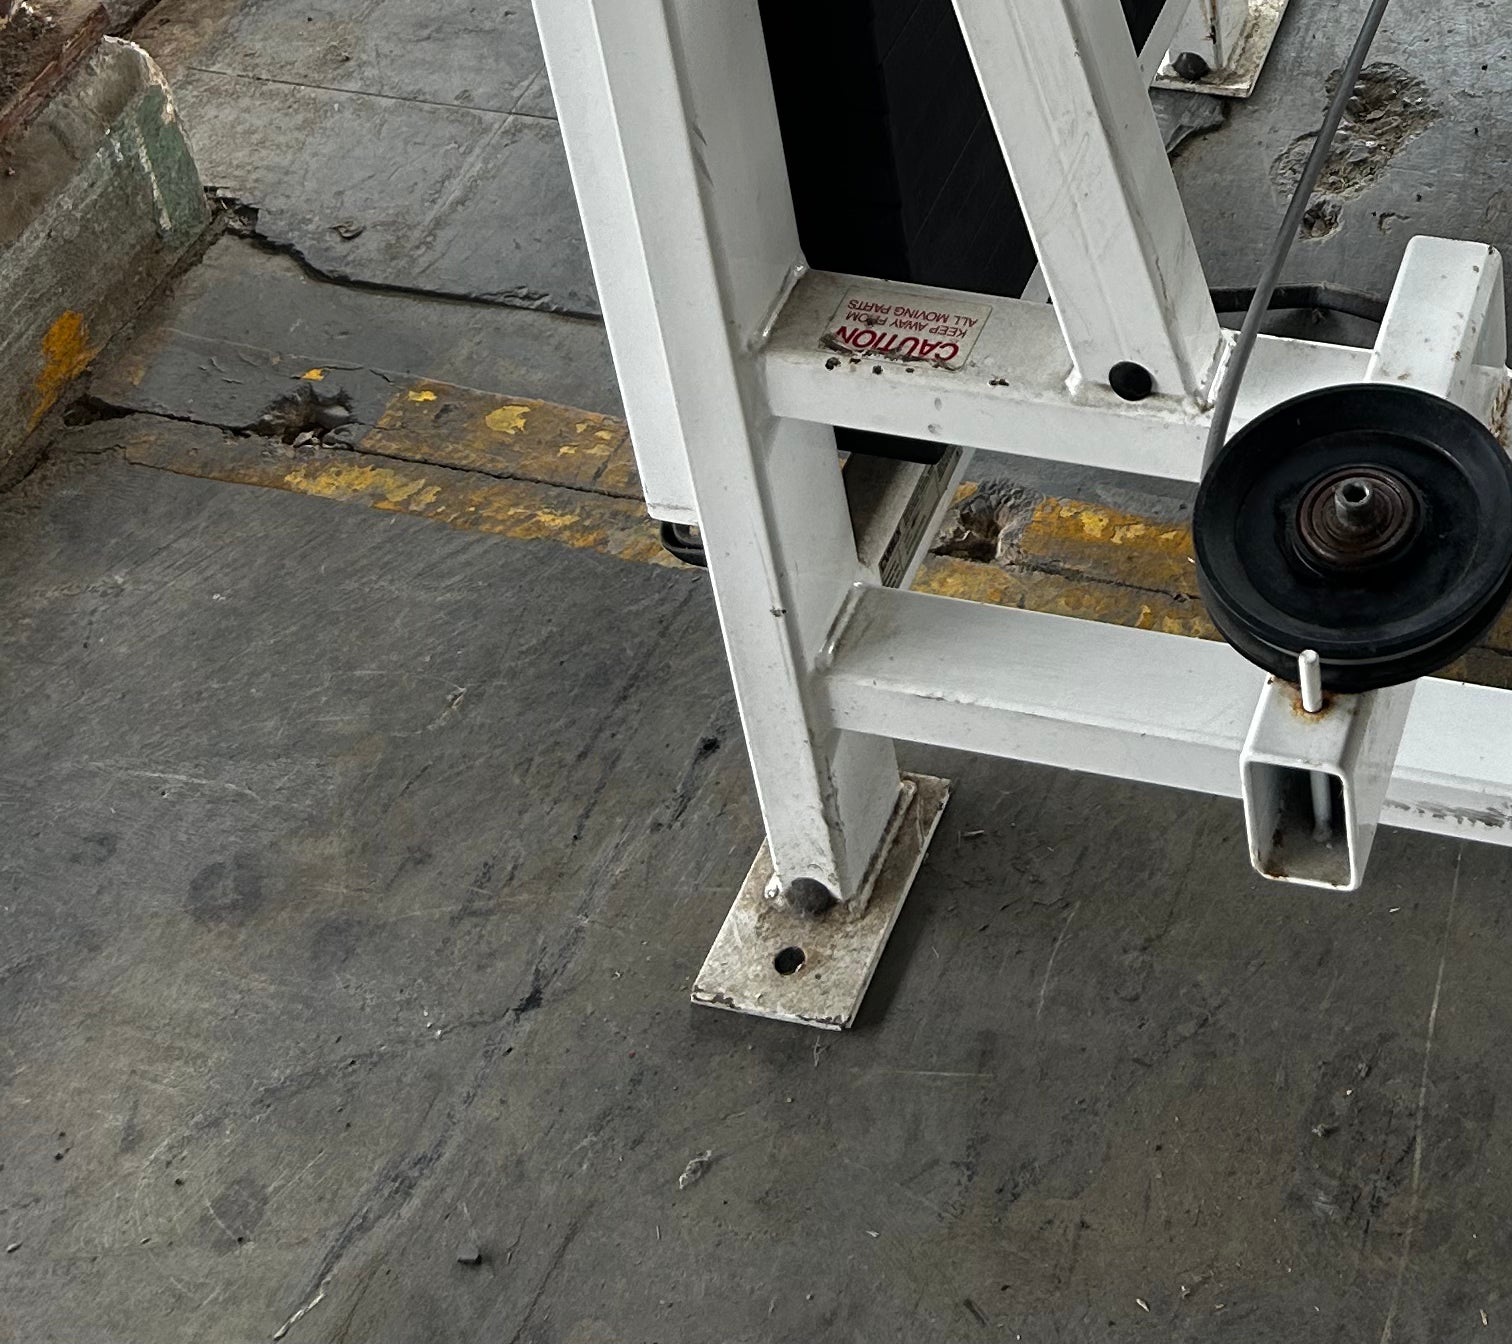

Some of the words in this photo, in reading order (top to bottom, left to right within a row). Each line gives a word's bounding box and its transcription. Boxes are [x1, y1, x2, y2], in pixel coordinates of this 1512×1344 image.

[847, 299, 892, 315] PARTS
[893, 306, 950, 323] MOVING
[954, 315, 979, 328] ALL
[890, 321, 929, 332] AWAY
[929, 327, 968, 338] KEEP
[836, 325, 959, 362] CAUTION
